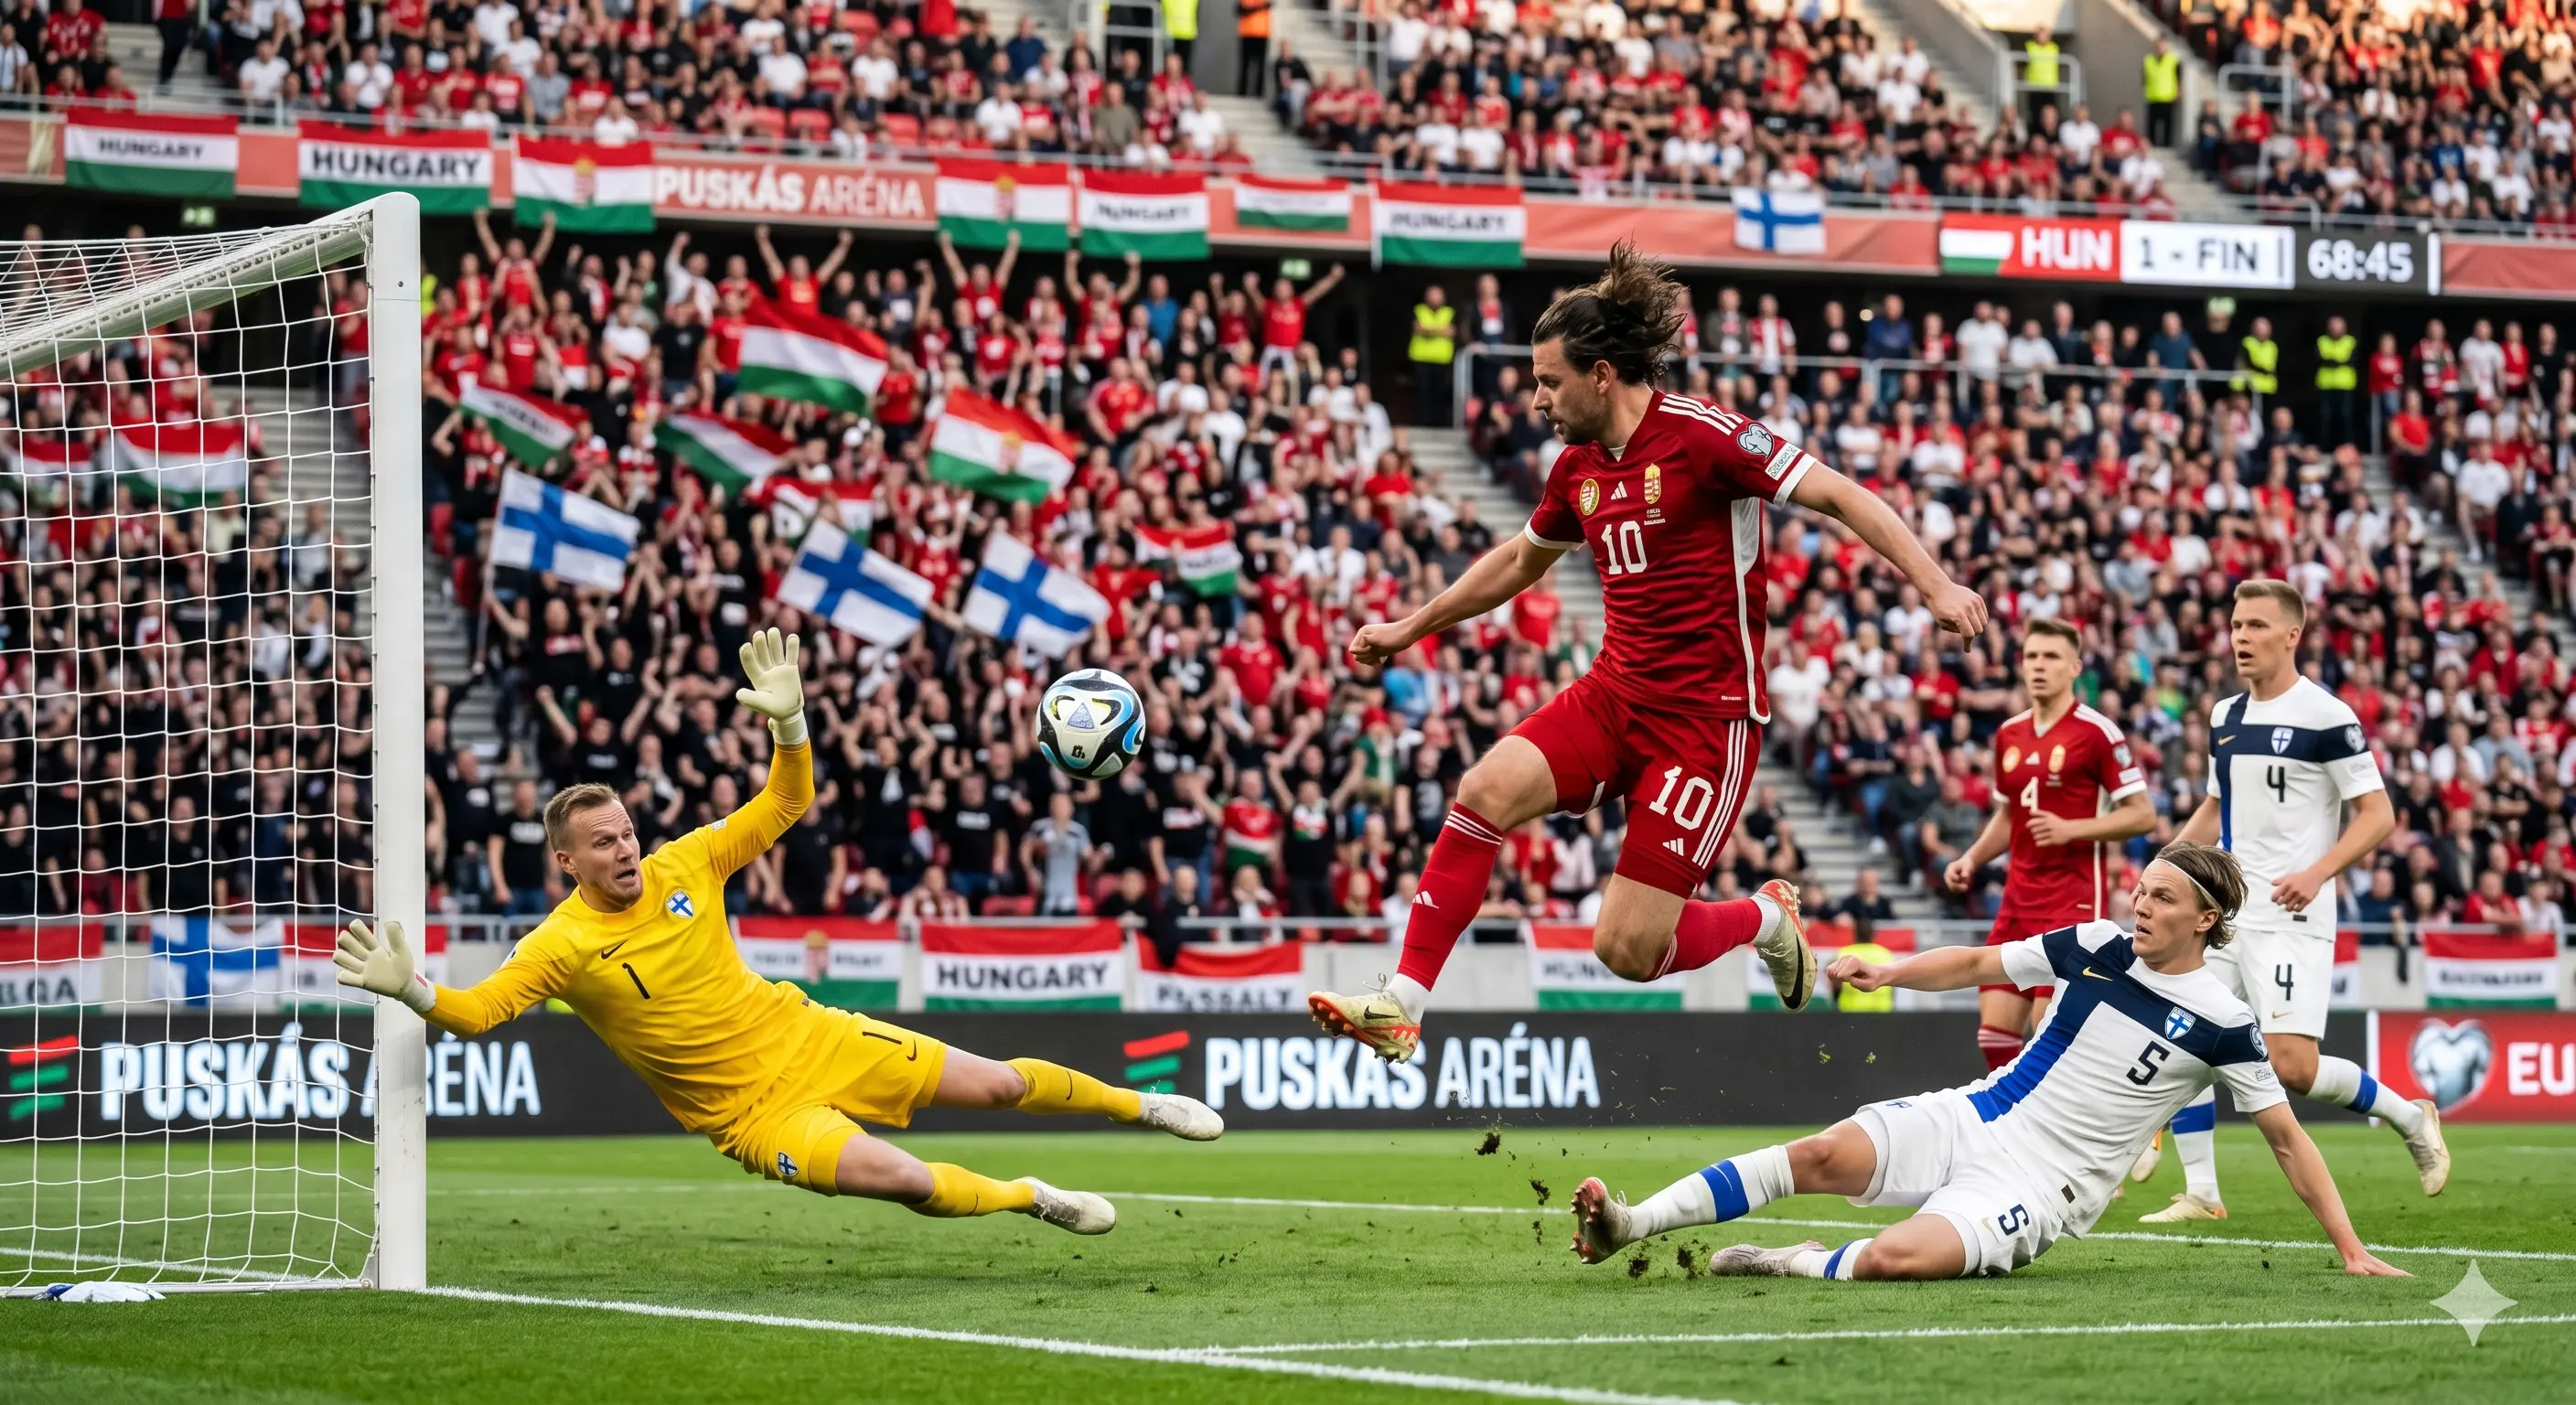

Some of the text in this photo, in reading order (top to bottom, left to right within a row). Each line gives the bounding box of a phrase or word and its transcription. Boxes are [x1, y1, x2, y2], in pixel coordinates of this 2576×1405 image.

[98, 136, 204, 159] HUNGARY
[313, 146, 481, 178] HUNGARY
[655, 163, 926, 218] PUSKÁS ARÉNA
[2021, 226, 2113, 271] HUN
[2140, 236, 2153, 269] 1
[2198, 238, 2259, 272] FIN
[2307, 238, 2415, 283] 68:45
[1602, 520, 1648, 574] 10
[1648, 766, 1714, 831] 10
[2020, 777, 2039, 812] 4
[2267, 765, 2285, 803] 4
[621, 962, 650, 1000] 1
[938, 961, 1109, 991] HUNGARY
[2275, 963, 2294, 1002] 4
[862, 1030, 903, 1046] 1
[100, 1021, 350, 1121] PUSKÁS
[1434, 1021, 1601, 1109] ARÉNA
[2126, 1040, 2170, 1086] 5
[2507, 1041, 2576, 1096] EU
[1998, 1203, 2030, 1237] 5
